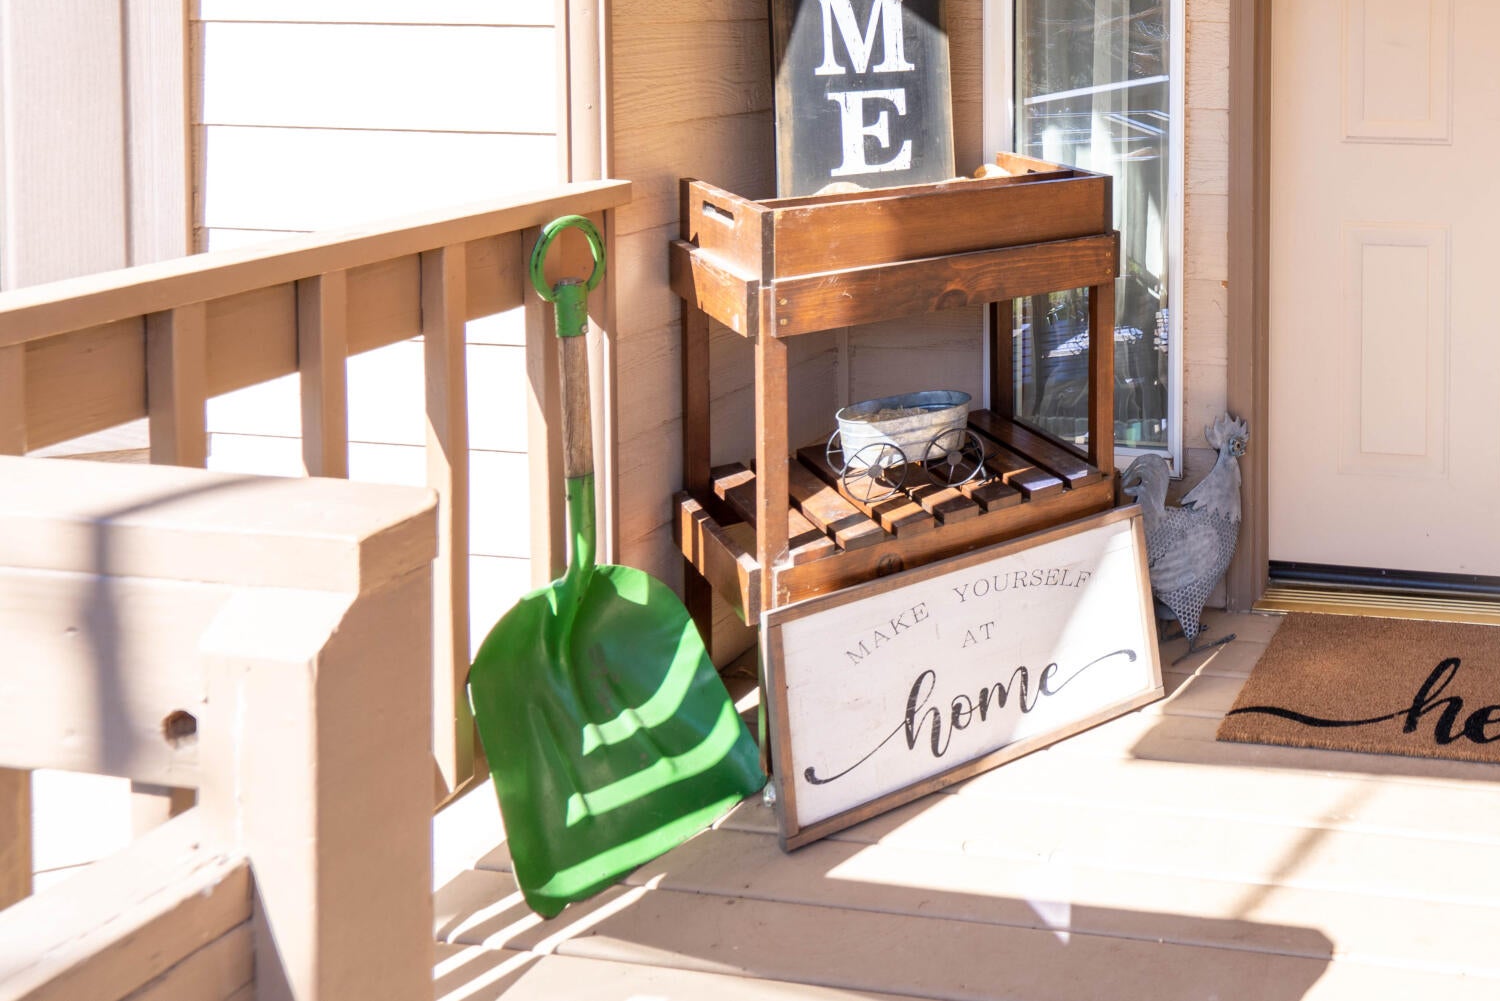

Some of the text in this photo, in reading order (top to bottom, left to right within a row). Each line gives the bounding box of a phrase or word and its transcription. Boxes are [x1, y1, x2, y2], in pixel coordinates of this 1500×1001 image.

[845, 567, 1092, 666] MAKE YOURSELF
[960, 621, 996, 649] AT
